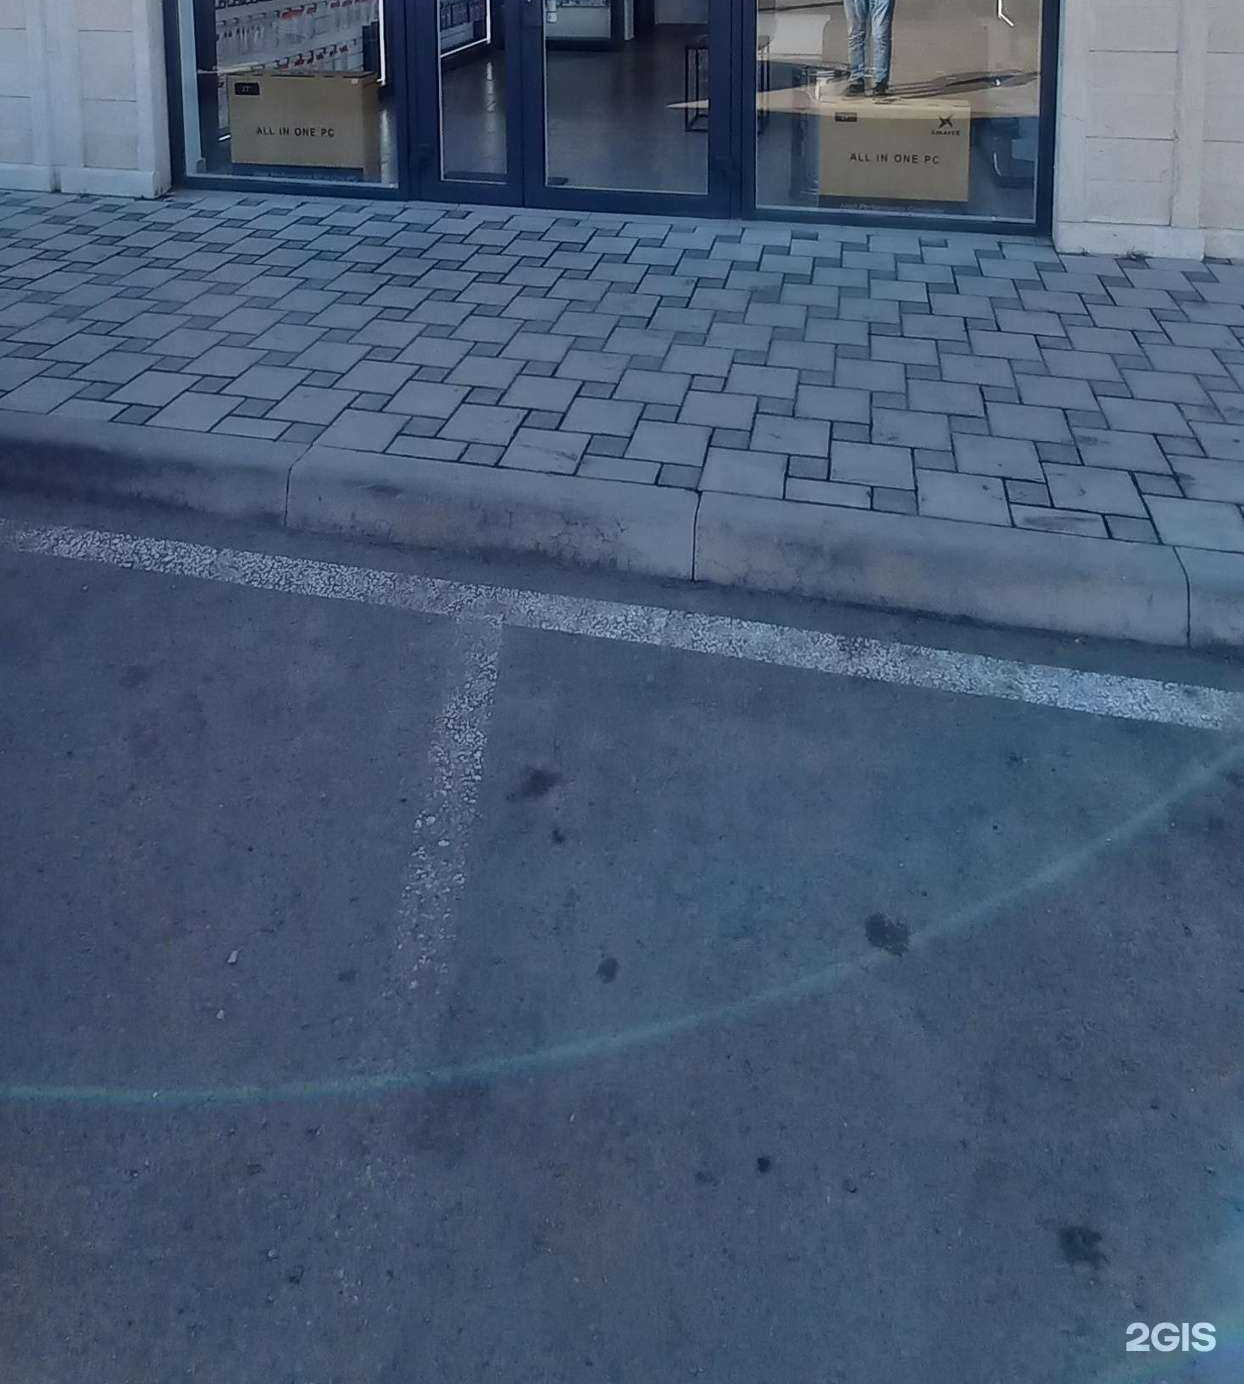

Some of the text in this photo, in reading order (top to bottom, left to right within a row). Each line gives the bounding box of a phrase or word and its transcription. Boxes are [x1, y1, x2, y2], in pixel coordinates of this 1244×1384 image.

[256, 126, 335, 137] ALL IN ONE PC
[849, 153, 940, 165] ALL IN ONE PC
